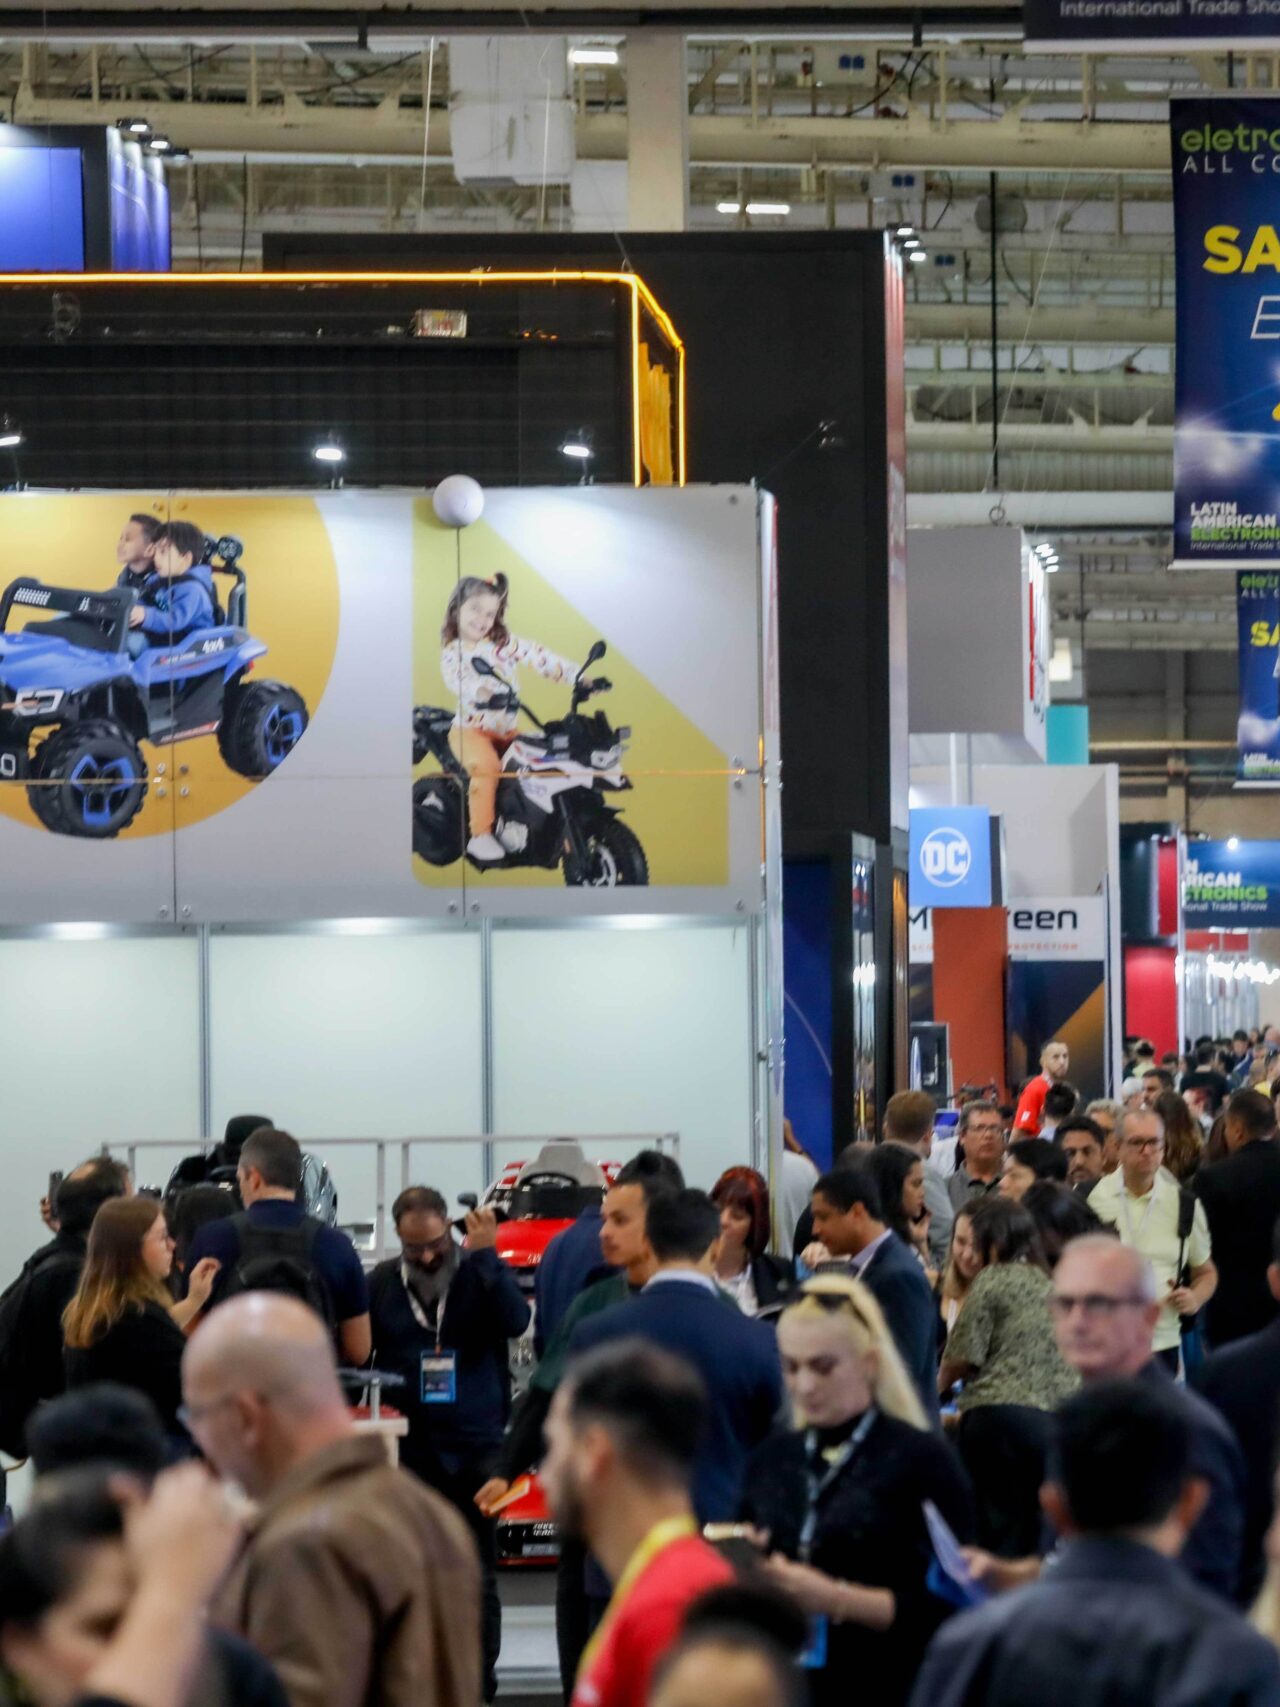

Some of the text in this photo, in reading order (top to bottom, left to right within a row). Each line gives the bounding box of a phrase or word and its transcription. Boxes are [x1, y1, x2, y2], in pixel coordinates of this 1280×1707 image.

[1059, 0, 1181, 17] International
[1190, 0, 1240, 15] Trade
[1183, 154, 1233, 174] ALL
[1190, 502, 1238, 517] LATIN
[1191, 514, 1277, 529] AMERICAN
[1190, 540, 1247, 551] International
[1250, 540, 1275, 551] Trade
[924, 840, 968, 876] DC
[1185, 872, 1241, 887] RICAN
